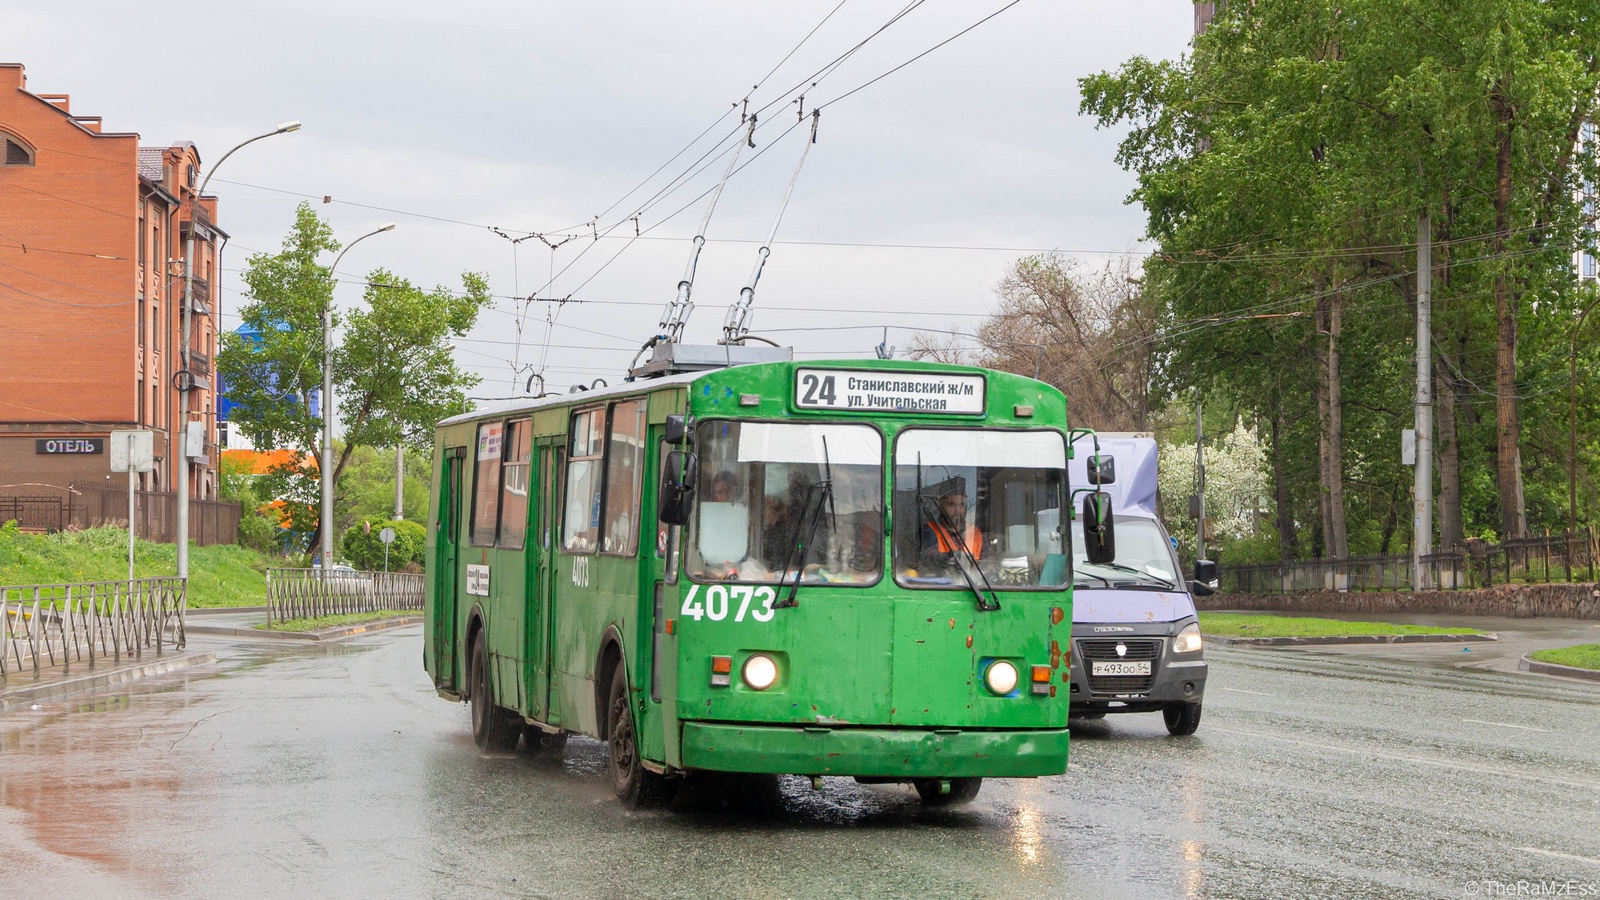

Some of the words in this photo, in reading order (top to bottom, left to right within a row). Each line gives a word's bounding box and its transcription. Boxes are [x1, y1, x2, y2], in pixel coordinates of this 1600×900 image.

[802, 374, 837, 406] 24
[848, 376, 945, 395] Станиславский
[947, 382, 974, 396] ж/м
[847, 394, 865, 407] ул.
[867, 394, 947, 410] Учительская
[45, 440, 95, 453] ОТЕЛЬ
[572, 555, 589, 588] 4073
[681, 584, 777, 622] 4073
